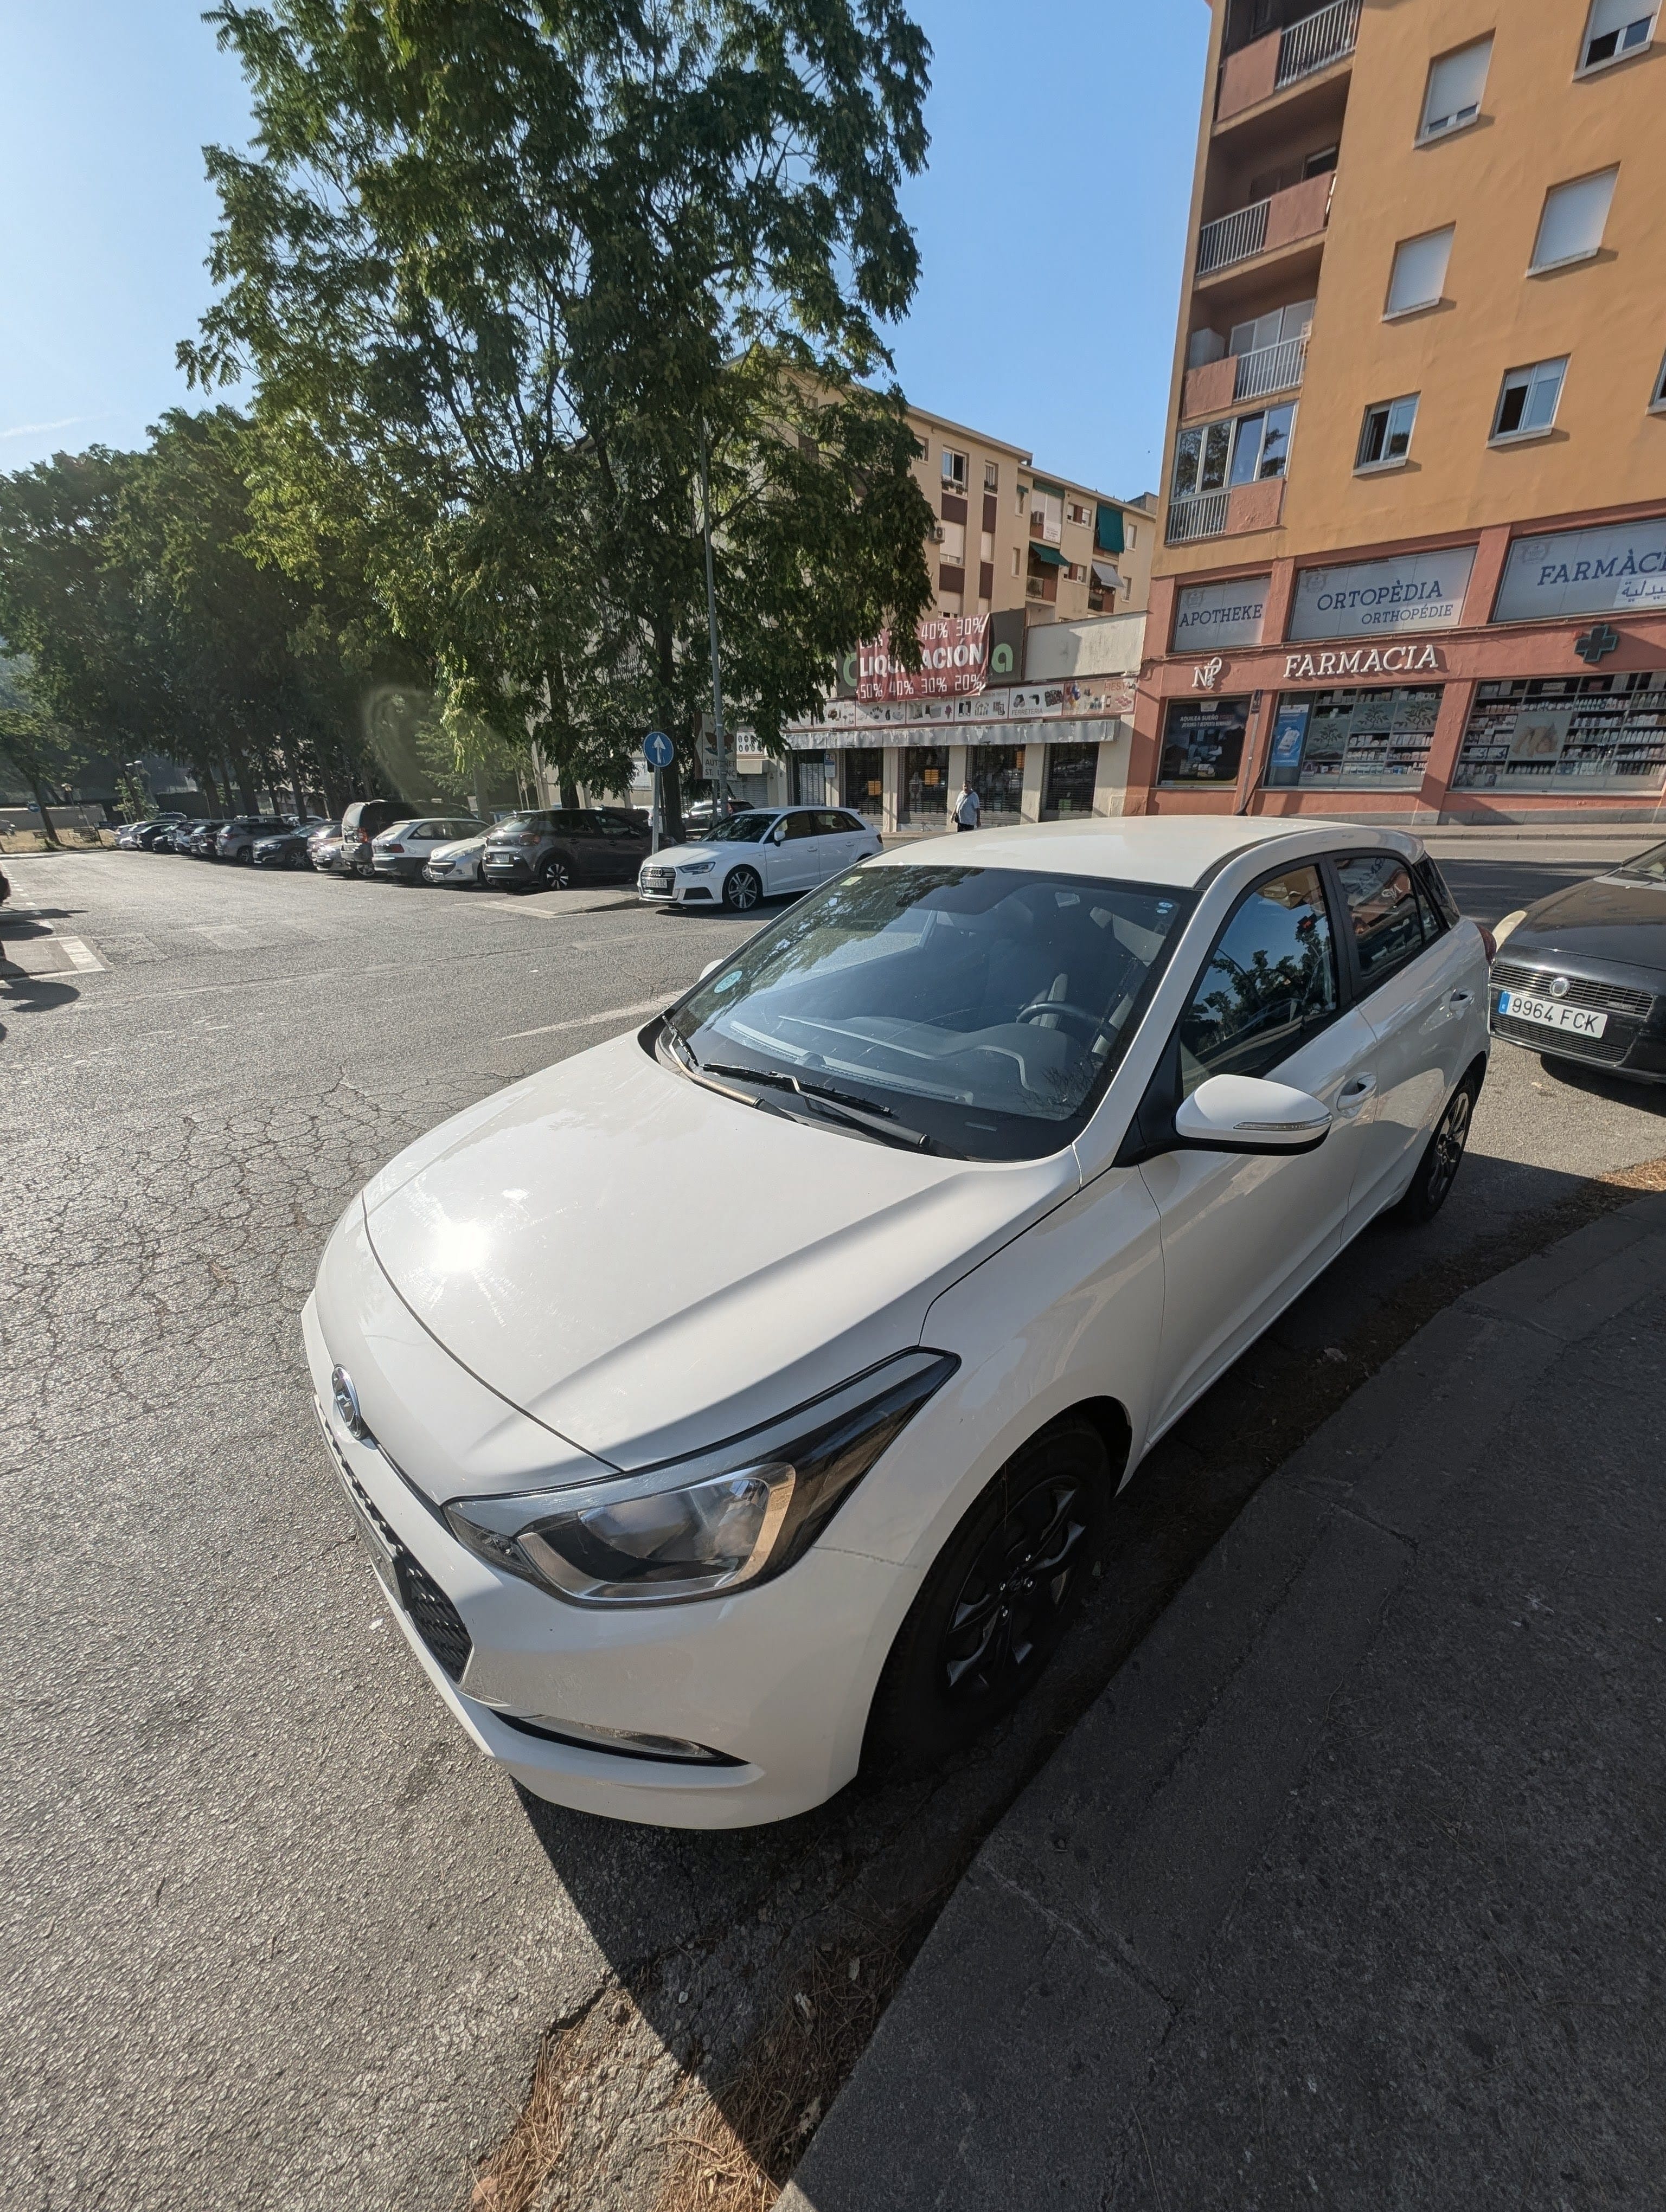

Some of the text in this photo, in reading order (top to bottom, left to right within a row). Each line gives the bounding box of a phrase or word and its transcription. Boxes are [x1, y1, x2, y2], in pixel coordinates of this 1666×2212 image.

[1317, 580, 1443, 611] ORTOPÈDIA
[1178, 604, 1263, 627] APOTHEKE
[1361, 603, 1454, 625] ORTHOPÉDIE
[921, 617, 986, 640] 40% 30%
[1283, 644, 1439, 678] FARMACIA
[860, 674, 983, 699] 50% 40% 30% 20%
[1511, 998, 1553, 1022] 9964
[1560, 1008, 1599, 1033] FCK
